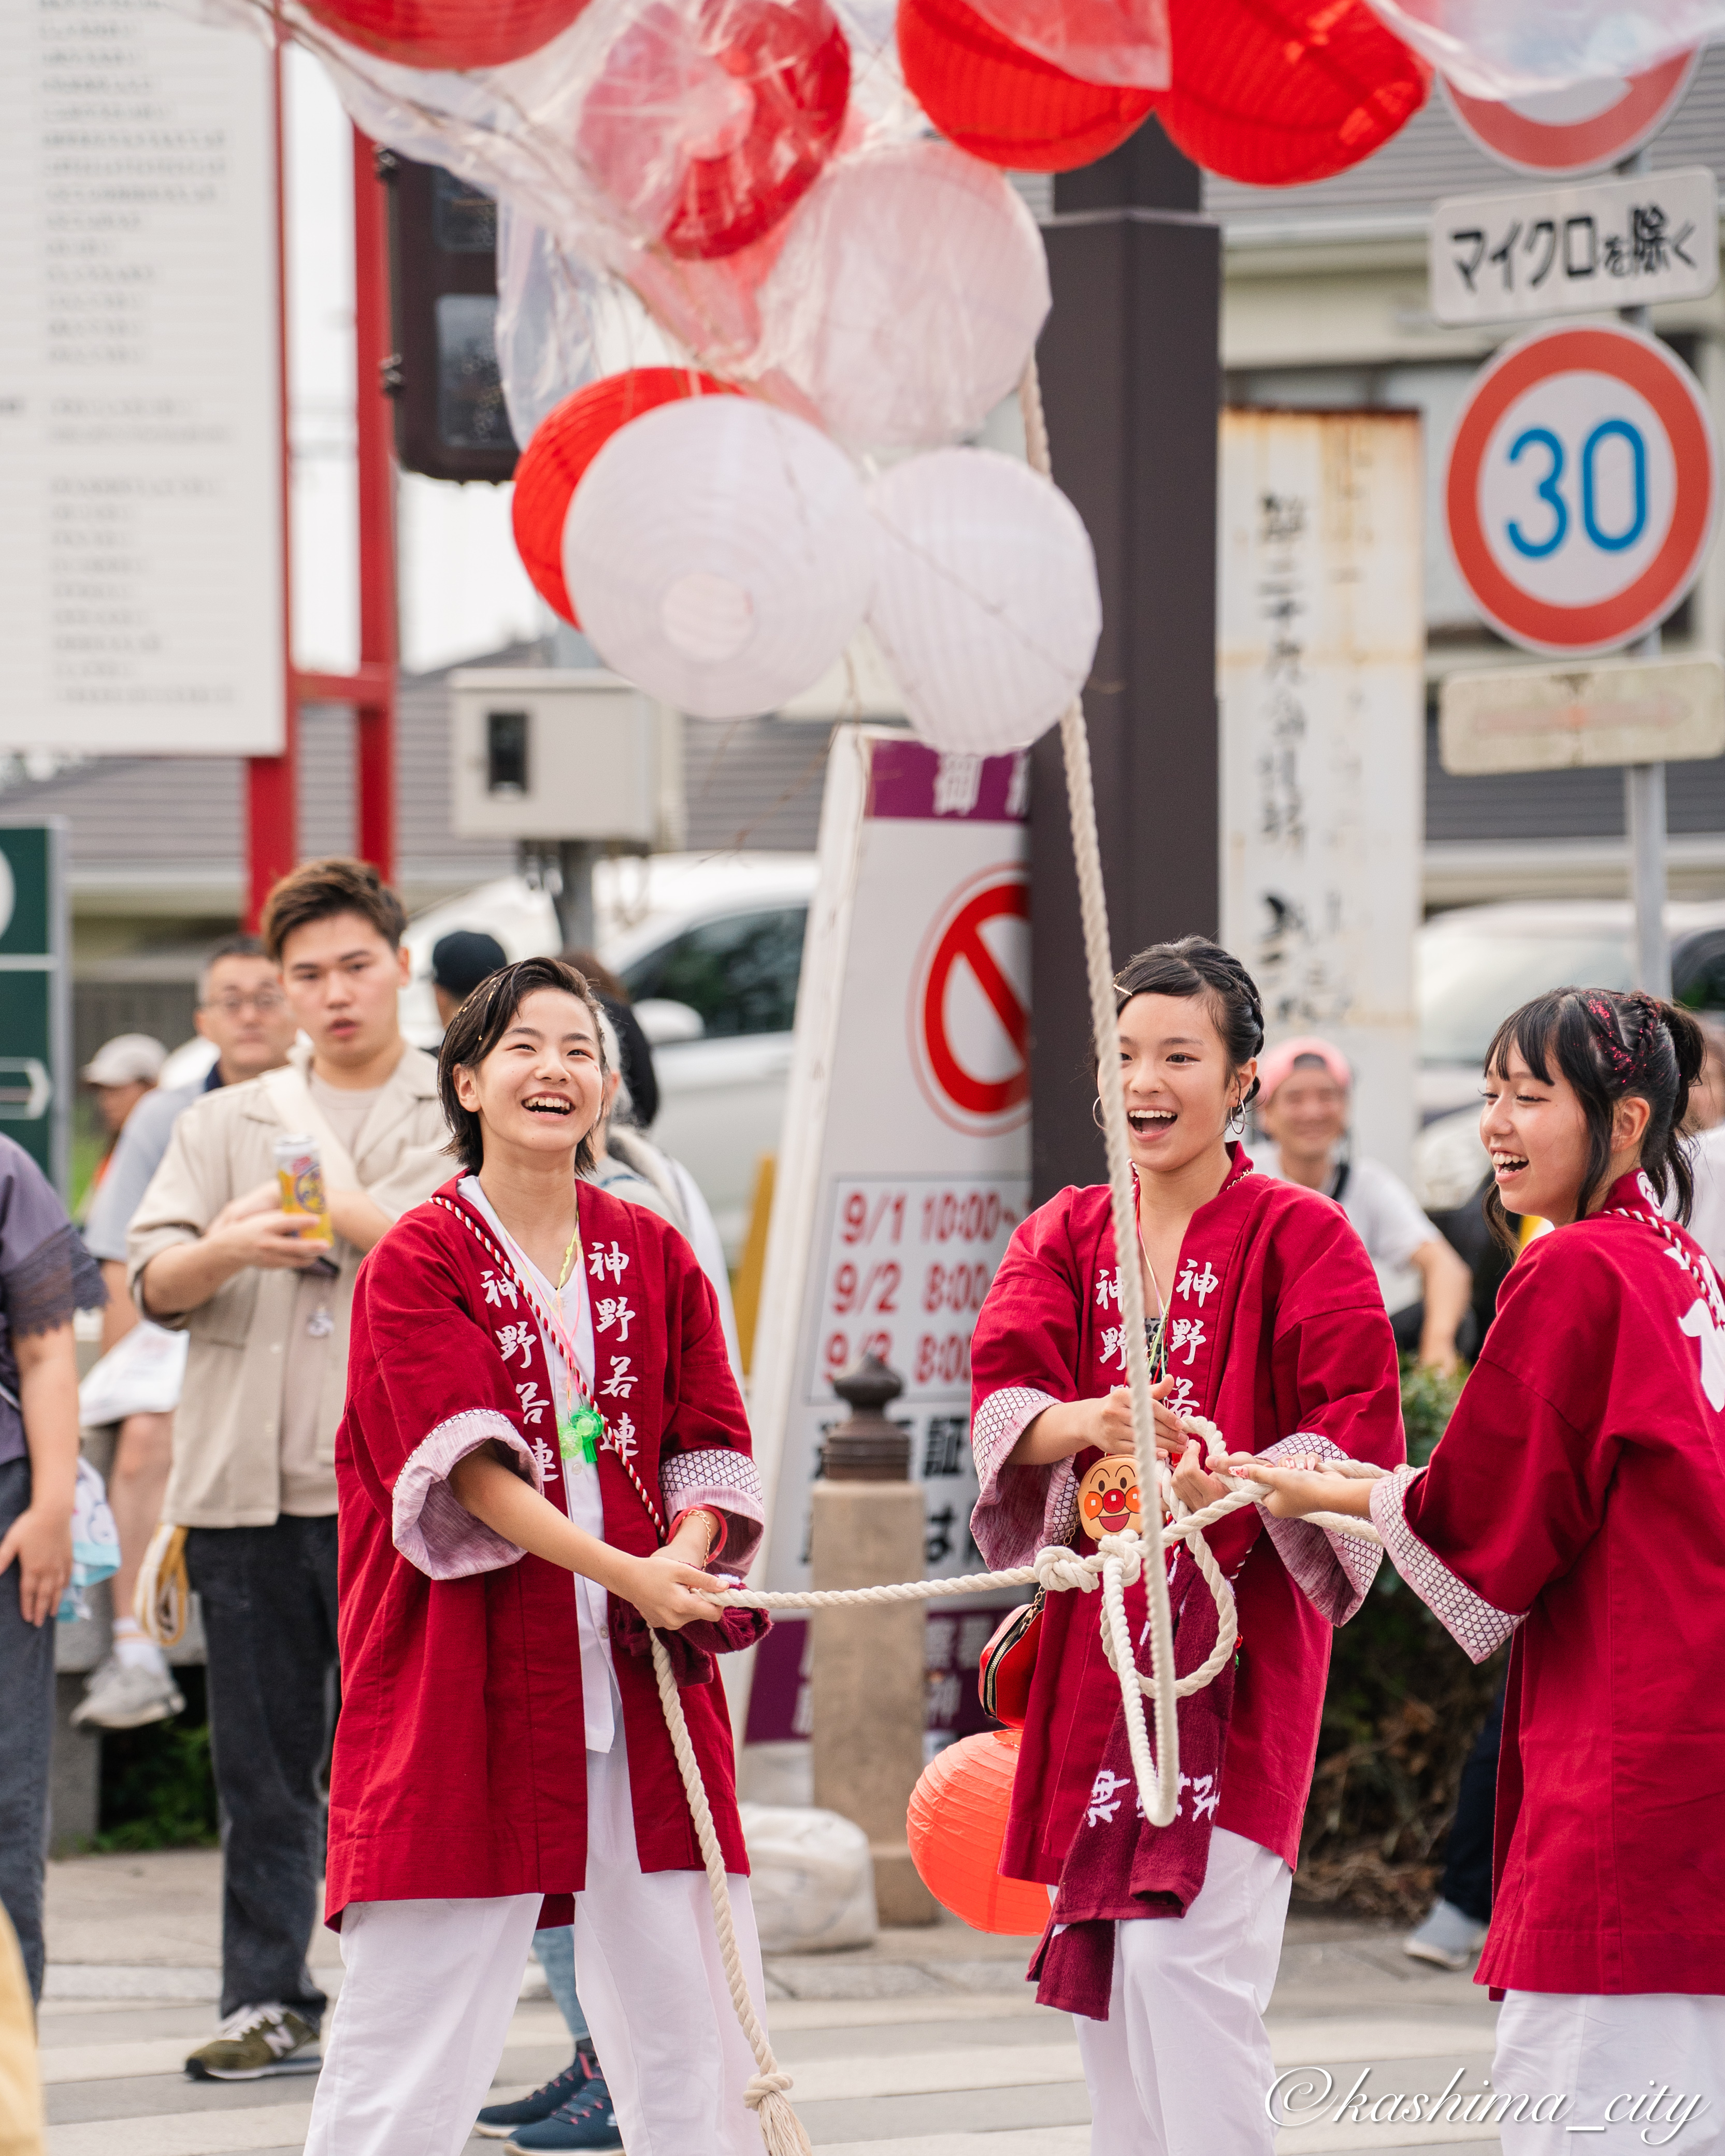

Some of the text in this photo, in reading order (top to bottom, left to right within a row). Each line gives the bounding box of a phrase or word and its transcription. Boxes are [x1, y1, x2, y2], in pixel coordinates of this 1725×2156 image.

[1450, 203, 1698, 293] マイクロを除く
[1505, 417, 1647, 558] 30
[841, 1190, 908, 1247] 9/1
[831, 1260, 902, 1315] 9/2
[1095, 1266, 1129, 1394] 神野
